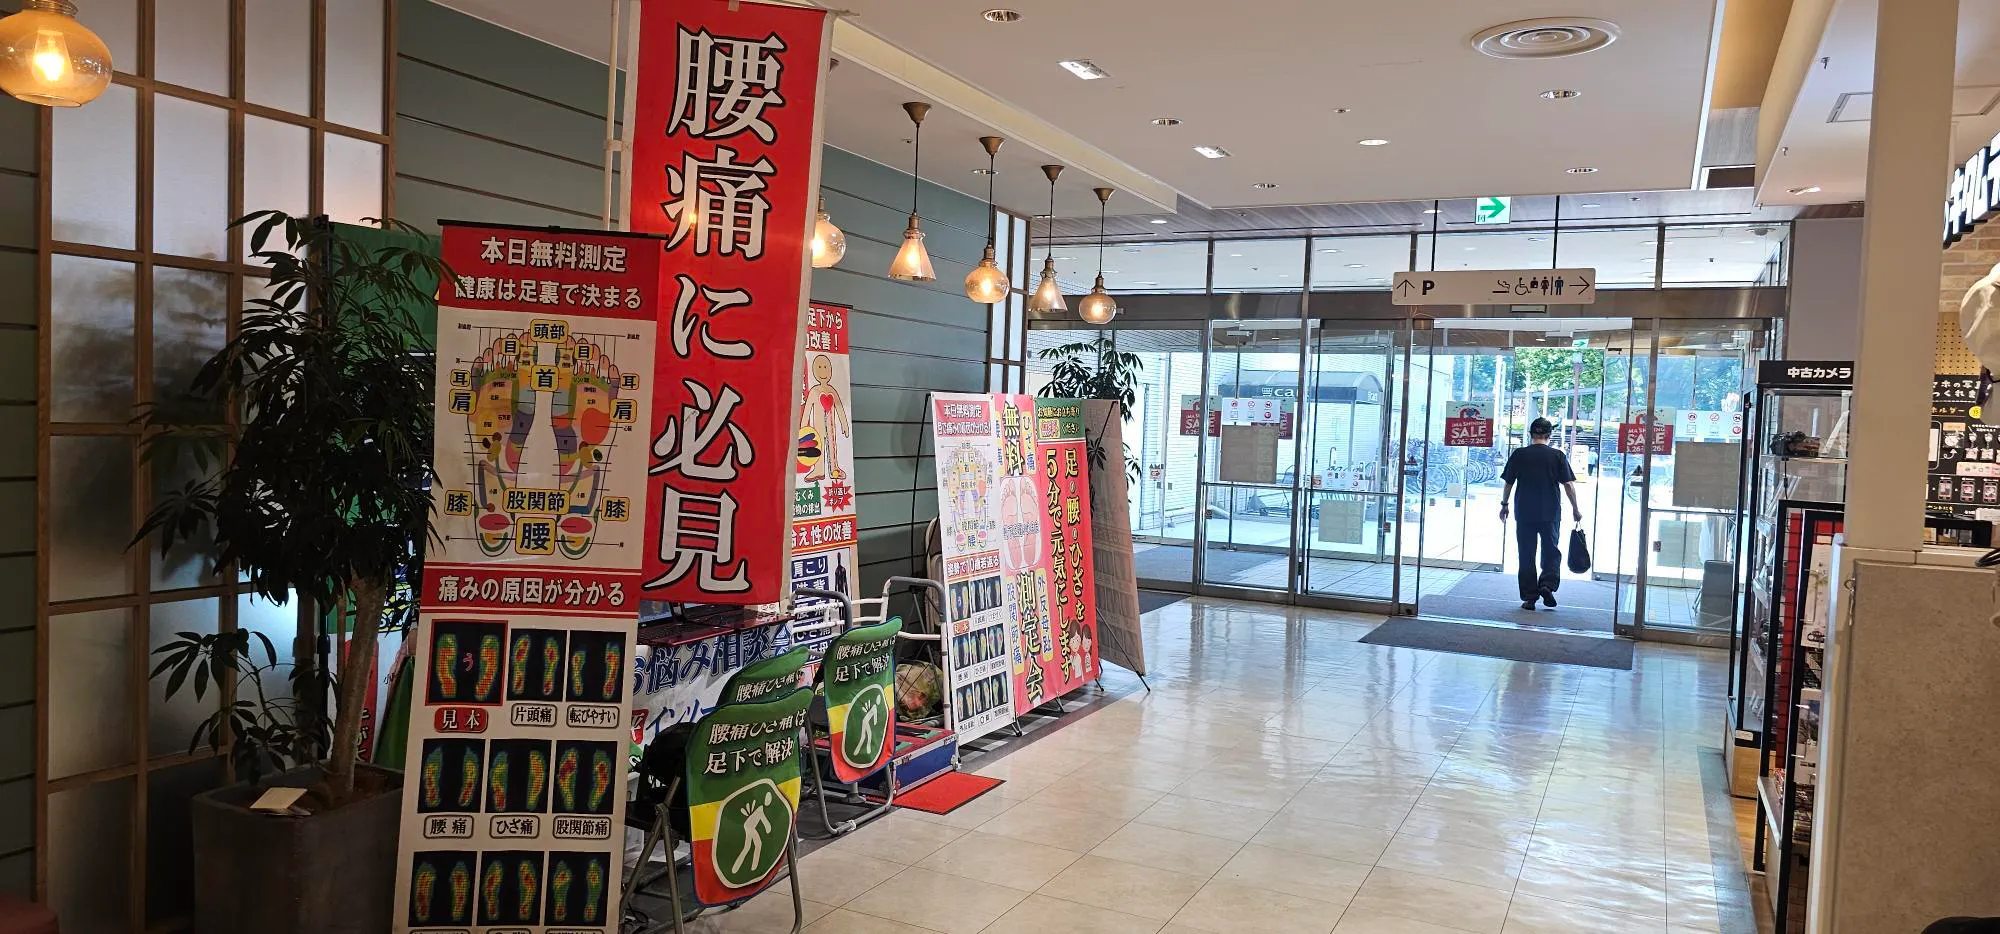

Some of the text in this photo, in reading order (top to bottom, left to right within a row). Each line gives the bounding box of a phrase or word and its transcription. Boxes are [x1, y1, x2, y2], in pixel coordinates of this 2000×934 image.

[480, 236, 627, 273] 本日無料測定
[454, 274, 641, 310] 健康は足裏で決まる
[1422, 280, 1435, 296] P
[643, 27, 787, 594] 腰痛に必見
[533, 323, 565, 341] 頭部
[504, 340, 517, 354] 目
[578, 345, 590, 359] 目
[452, 371, 468, 386] 耳
[535, 368, 555, 388] 首
[621, 375, 637, 389] 耳
[1787, 366, 1852, 379] 中古カメラ
[451, 392, 471, 413] 肩
[612, 403, 632, 421] 肩
[1002, 401, 1024, 477] 無料
[1450, 426, 1487, 439] SALE
[1626, 432, 1665, 446] SAE
[446, 493, 468, 513] 膝
[506, 492, 566, 512] 股関節
[604, 500, 626, 519] 膝
[519, 522, 551, 551] 腰
[793, 558, 826, 579] 肩こり
[438, 576, 626, 606] 痛みの原因が分かる
[1017, 570, 1044, 704] 測定会
[441, 709, 481, 730] 見本
[513, 706, 553, 724] 片頭痛
[568, 709, 617, 725] 転びやすい
[708, 708, 807, 745] 腰痛ひざ痛は
[703, 736, 795, 775] 足下で解決
[430, 818, 467, 835] 腰痛
[495, 819, 534, 834] ひざ痛
[555, 820, 608, 836] 股関節痛
